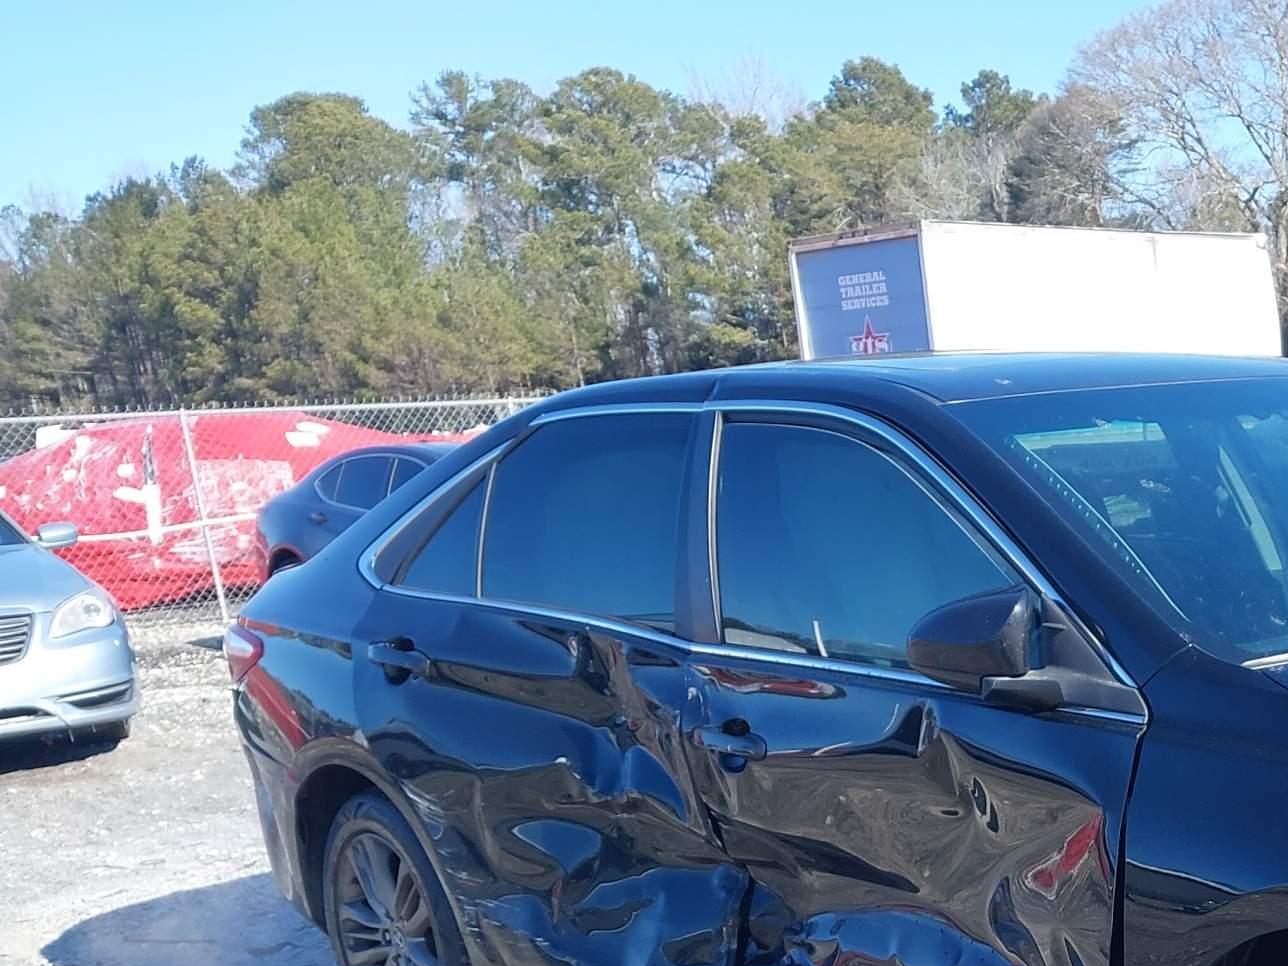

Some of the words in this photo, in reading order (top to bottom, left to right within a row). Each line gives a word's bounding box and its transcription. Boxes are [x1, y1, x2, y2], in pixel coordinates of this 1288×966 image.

[838, 271, 886, 286] GENERAL
[840, 282, 887, 298] TRAILER
[841, 295, 889, 310] SERVICES
